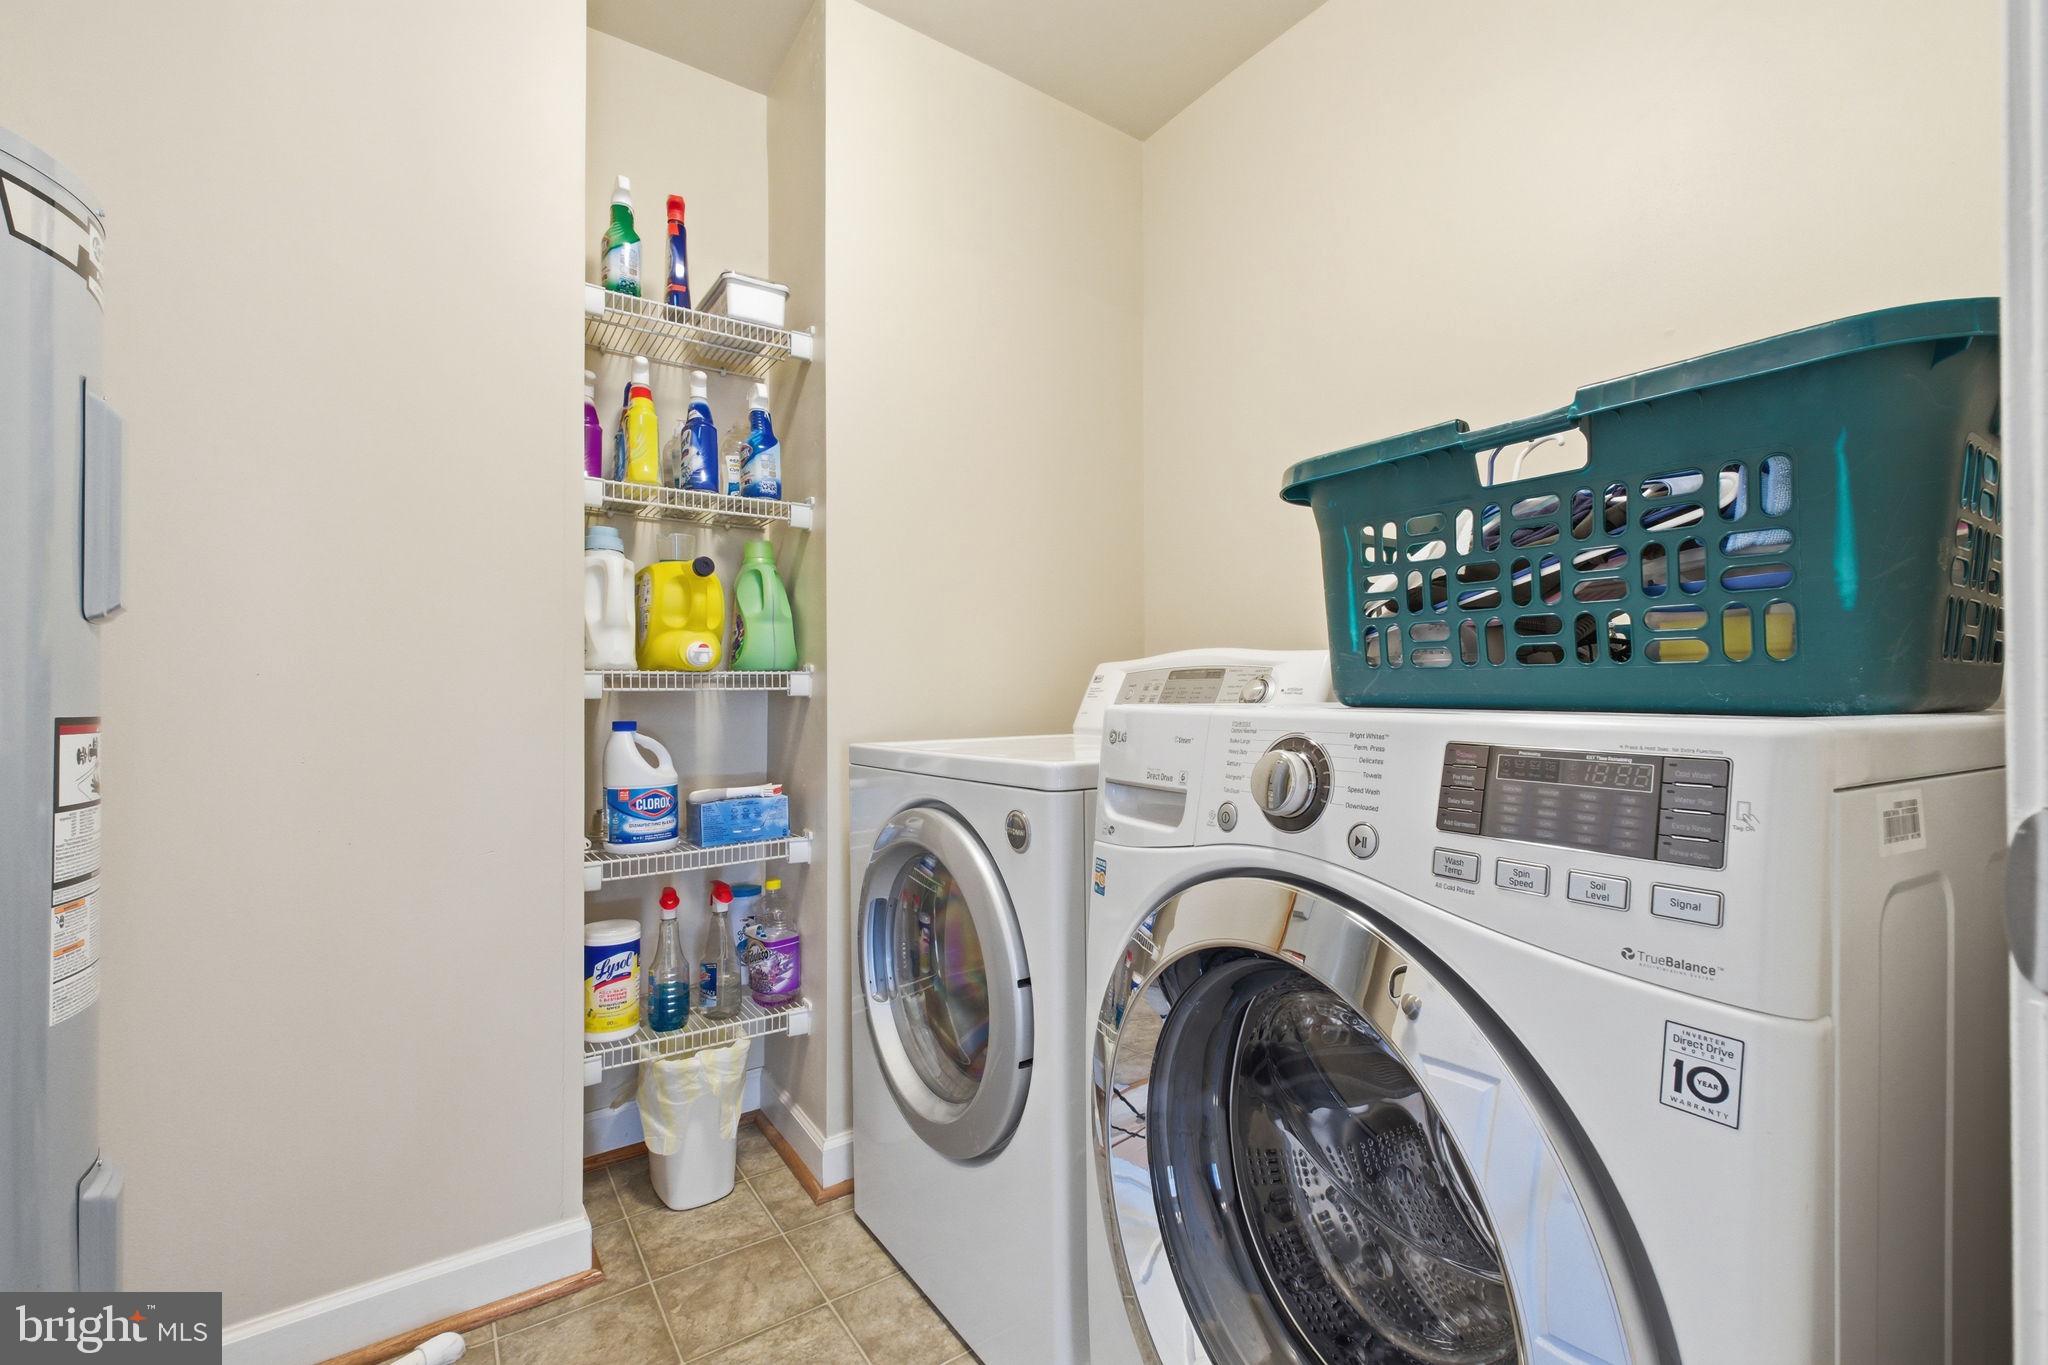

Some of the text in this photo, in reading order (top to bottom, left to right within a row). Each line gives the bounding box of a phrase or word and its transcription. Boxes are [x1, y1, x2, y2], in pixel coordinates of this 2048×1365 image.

[1118, 731, 1127, 743] LG
[1349, 732, 1365, 740] Bright
[1358, 757, 1384, 765] Delicates
[1363, 771, 1382, 780] Towels
[1347, 786, 1380, 796] Speed Wash
[636, 797, 671, 811] CLOROX
[1345, 802, 1379, 812] Downloaded
[1445, 856, 1465, 867] Wash
[1512, 868, 1531, 879] Spin
[1443, 883, 1456, 891] Cold
[1456, 885, 1475, 895] Rinses
[1508, 877, 1534, 889] Speed
[1590, 881, 1607, 891] Soil
[1585, 890, 1610, 902] Level
[1670, 898, 1701, 912] Signal
[596, 952, 632, 980] Lysol
[1637, 950, 1716, 976] TrueBalance
[1682, 1030, 1726, 1046] INVERTER
[1673, 1033, 1735, 1059] Direct Drive
[1682, 1046, 1725, 1062] MOTOR
[1673, 1058, 1730, 1104] 10
[1696, 1078, 1719, 1092] YEAR
[1670, 1095, 1729, 1120] WARRANTY
